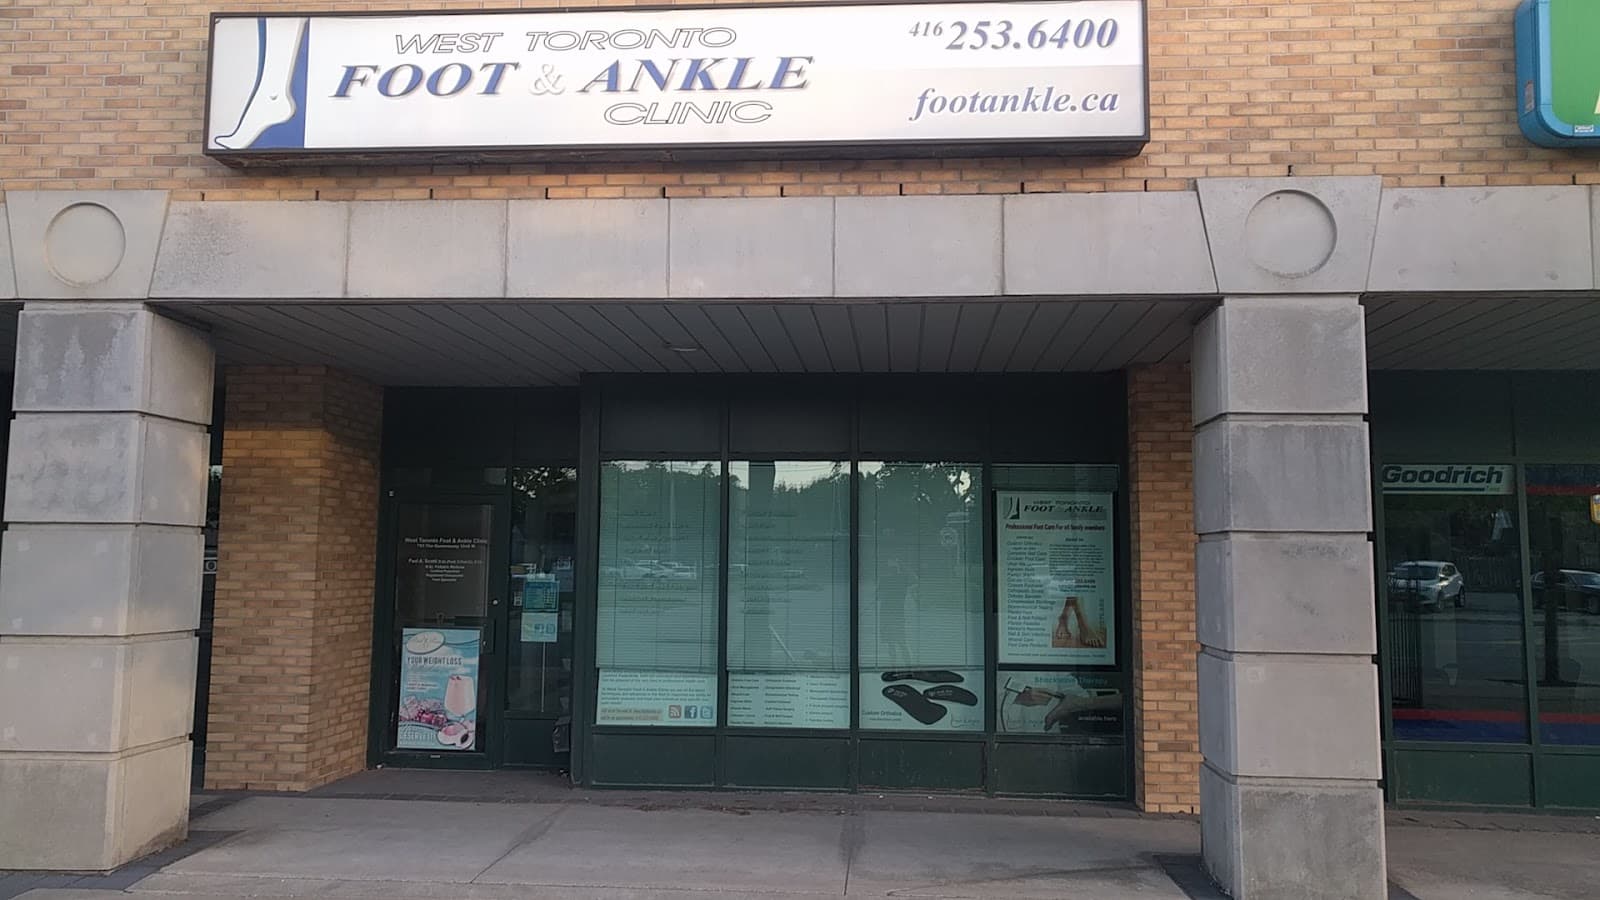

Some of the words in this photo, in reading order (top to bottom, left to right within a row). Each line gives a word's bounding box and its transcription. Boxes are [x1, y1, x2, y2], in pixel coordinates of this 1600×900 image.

[394, 32, 504, 54] WEST
[526, 27, 736, 52] TORONTO
[909, 22, 943, 38] 416
[945, 18, 1119, 50] 253.6400
[333, 62, 520, 98] FOOT
[528, 63, 566, 96] &
[577, 56, 814, 92] ANKLE
[603, 100, 773, 125] CLINIC
[908, 85, 1119, 122] footankle.ca
[1382, 465, 1503, 484] Goodrich
[1064, 505, 1104, 513] ANKLE
[423, 656, 445, 665] WEIGHT
[446, 656, 463, 666] LOSS
